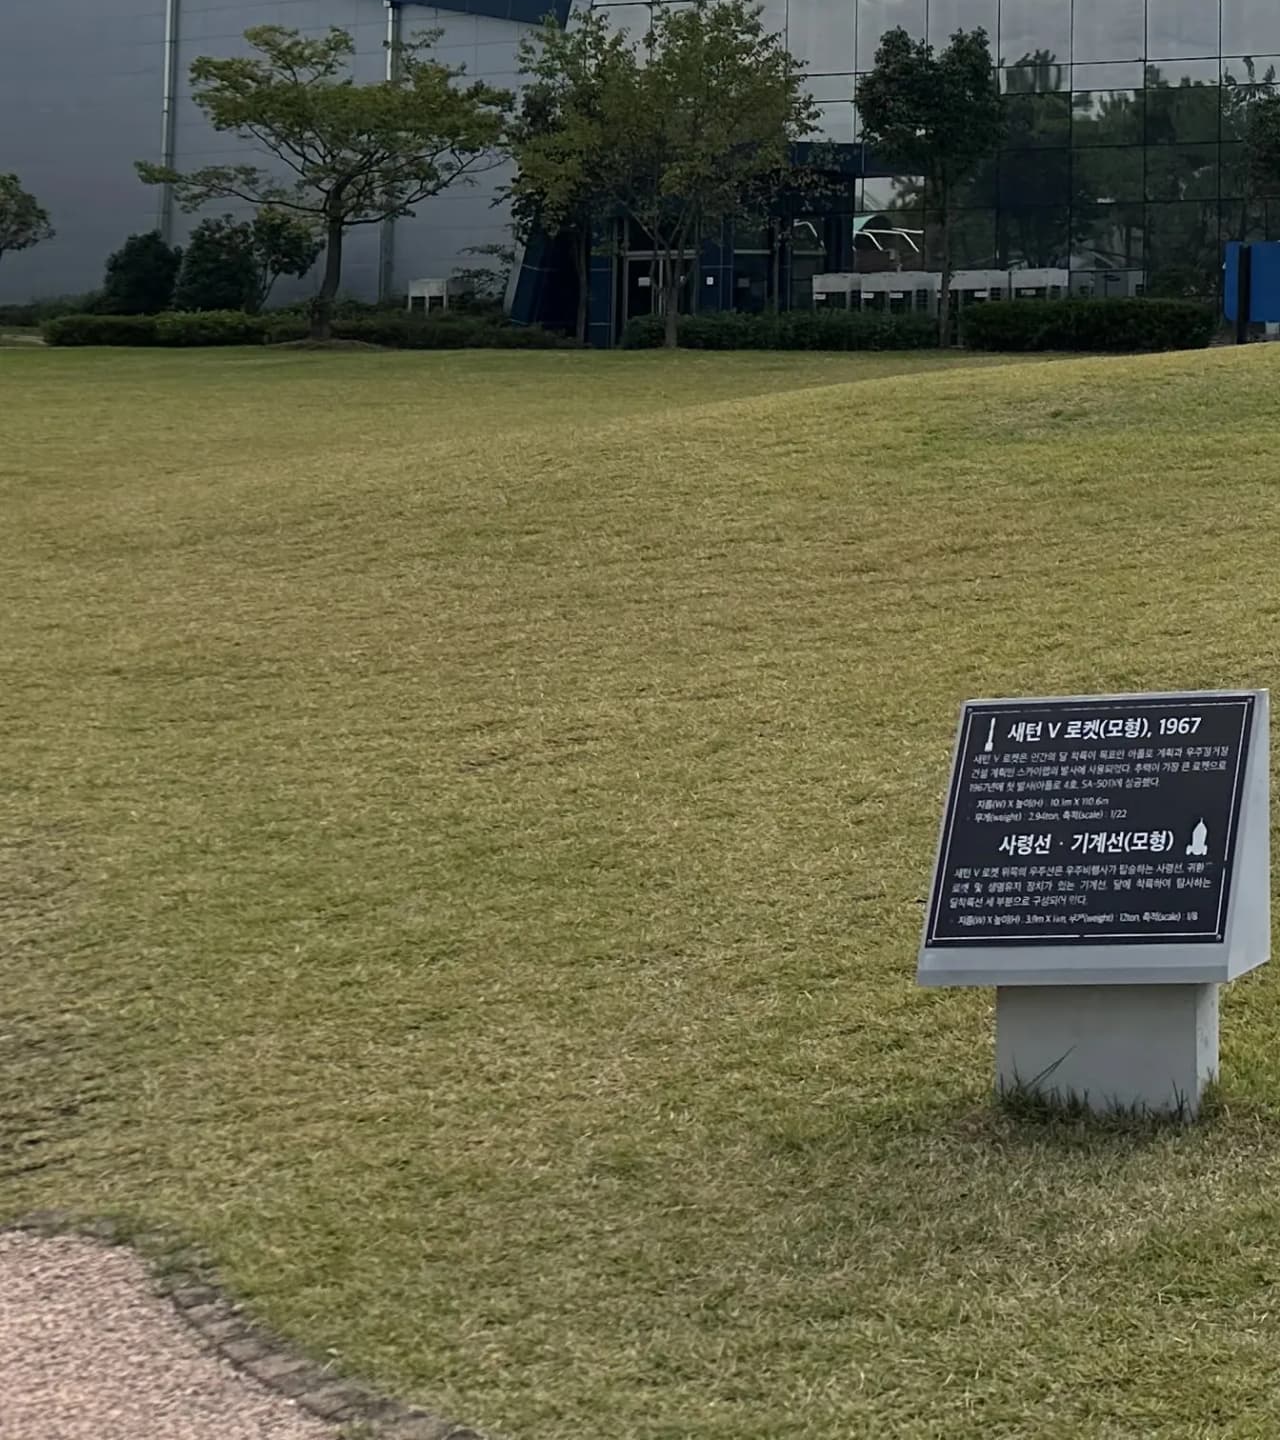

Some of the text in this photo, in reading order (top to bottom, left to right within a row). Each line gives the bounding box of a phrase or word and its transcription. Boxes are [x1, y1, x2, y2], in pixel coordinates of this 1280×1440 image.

[1007, 717, 1202, 742] 새턴 V 로켓(모형), 1967
[998, 834, 1051, 855] 사령선
[1070, 831, 1174, 854] 기계선(모형)
